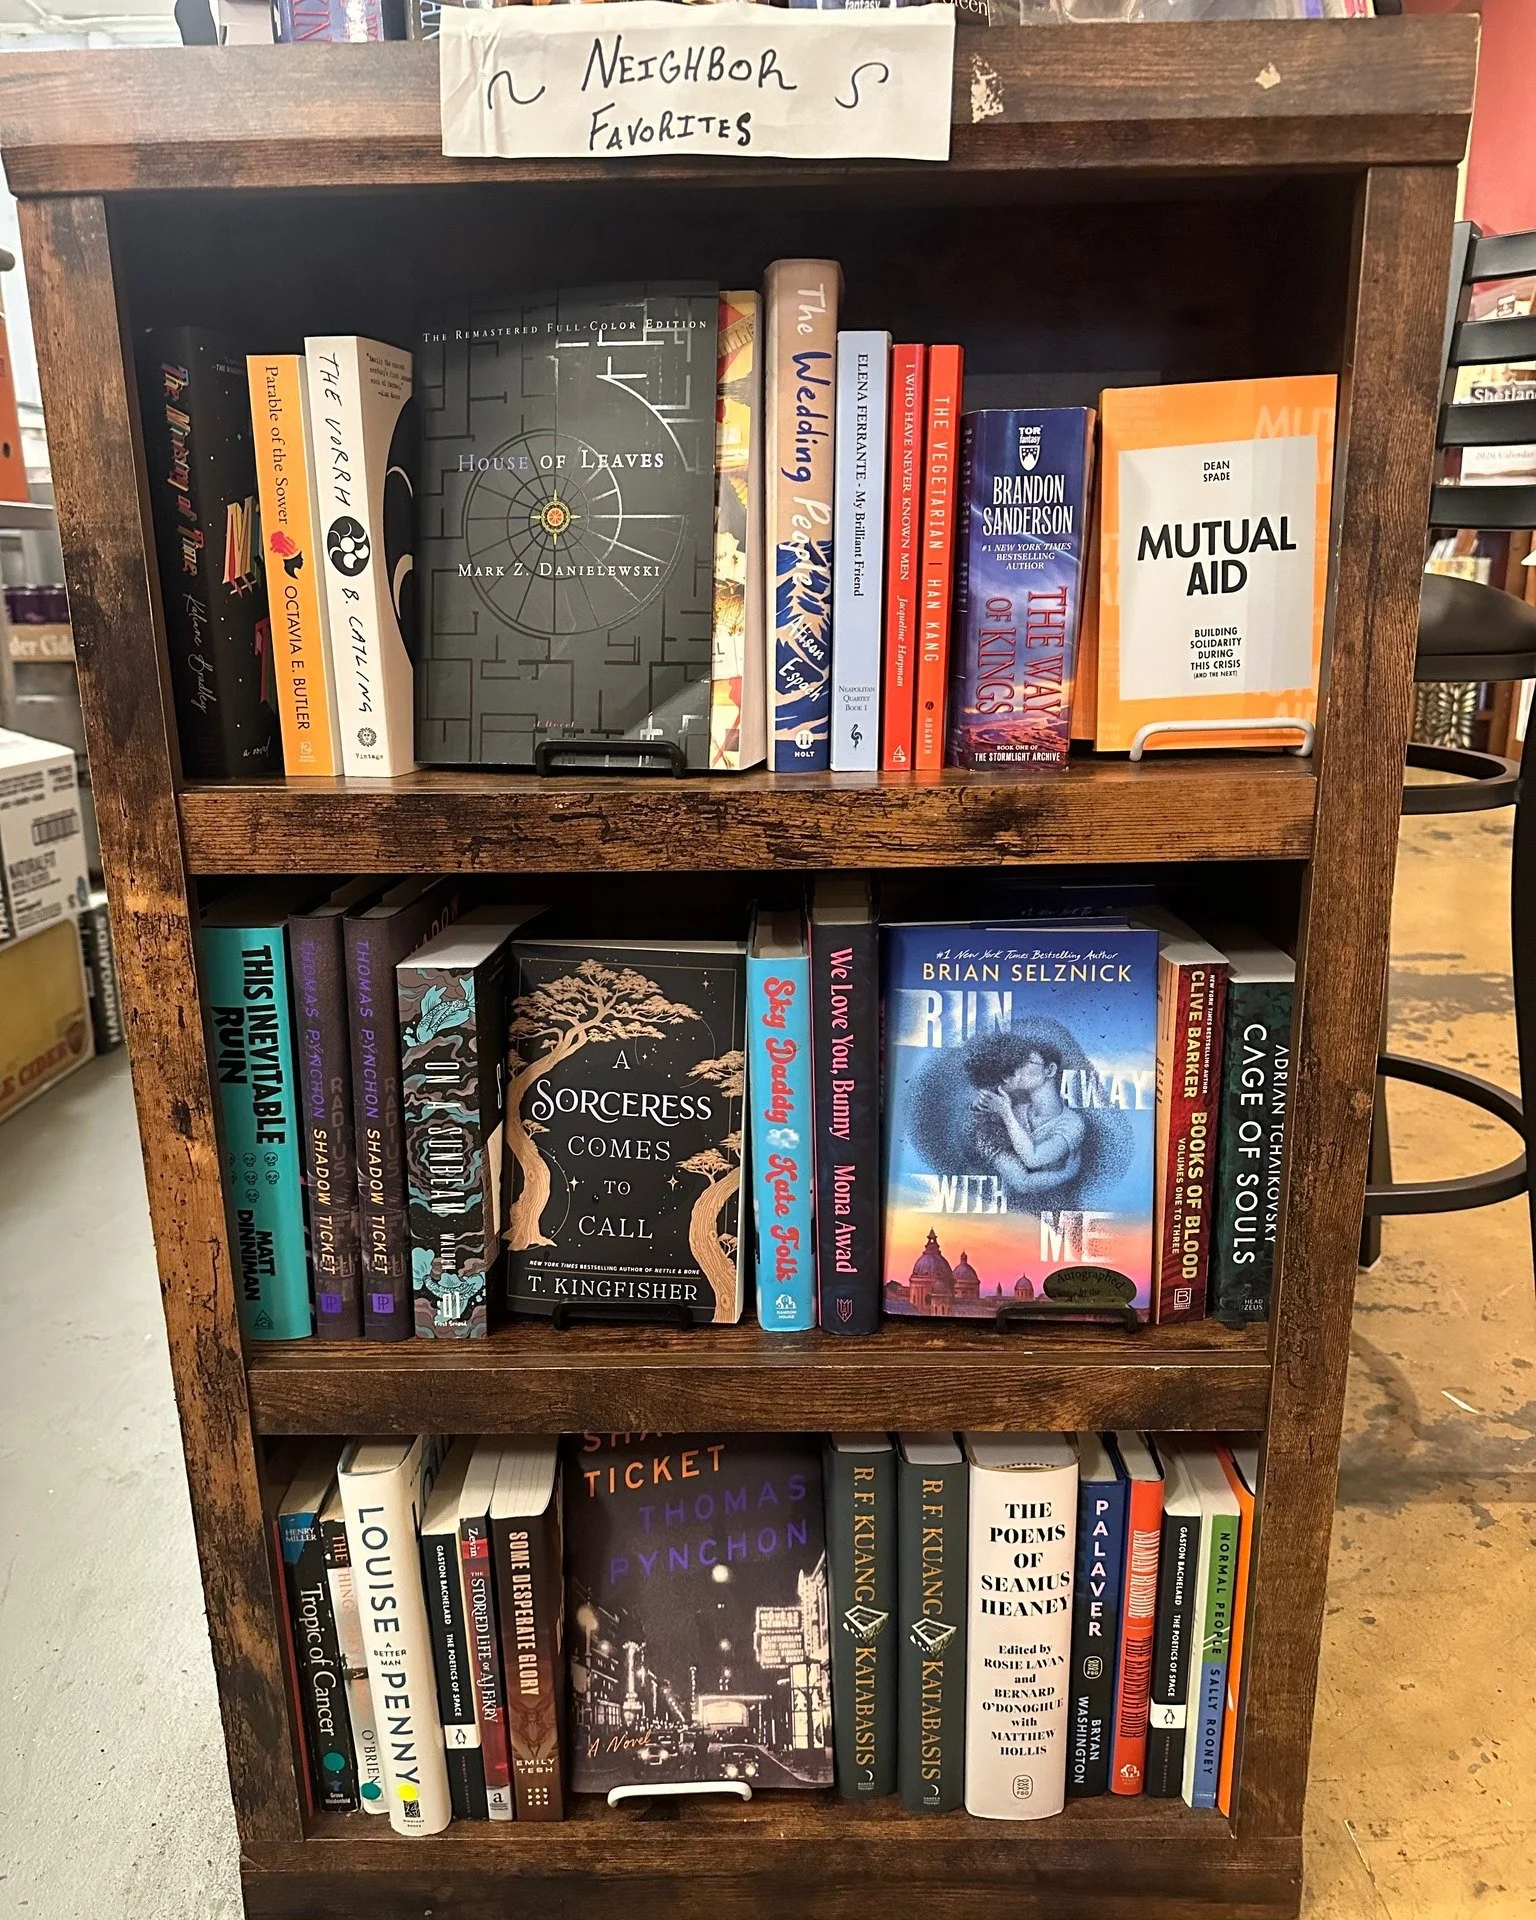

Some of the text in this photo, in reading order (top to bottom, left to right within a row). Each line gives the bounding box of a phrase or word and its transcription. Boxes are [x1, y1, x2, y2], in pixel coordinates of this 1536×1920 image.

[582, 35, 796, 92] NEIGHBOR
[588, 102, 752, 152] FAVORITES
[423, 319, 707, 342] THE REMASTERED FULL-COLOR EDITION
[905, 372, 915, 407] WHO
[1474, 388, 1536, 401] Shetlan
[265, 366, 289, 525] Parable of the Sower
[319, 353, 352, 507] THE VORRH
[780, 283, 832, 586] The Wedding People
[904, 410, 914, 448] HAVE
[1019, 426, 1040, 435] TOR
[1019, 435, 1040, 444] fantasy
[458, 450, 665, 472] HOUSE OF LEAVES
[853, 353, 868, 597] ELENA FERRANTE My Brilliant Friend
[903, 451, 912, 493] NEVER
[928, 396, 950, 549] THE VEGETARIAN
[1203, 460, 1231, 471] DEAN
[1203, 472, 1231, 483] SPADE
[993, 474, 1065, 504] BRANDON
[901, 497, 911, 548] KNOWN
[982, 506, 1073, 536] SANDERSON
[1137, 516, 1297, 561] MUTUAL
[458, 563, 660, 577] MARK Z. DANIELEWSKI
[900, 552, 909, 580] MEN
[996, 552, 1055, 561] BESTSELLING
[1005, 562, 1044, 570] AUTHOR
[1186, 559, 1248, 597] AID
[895, 595, 909, 687] Jacqueline Harpman
[924, 579, 942, 662] HAN KANG
[1194, 627, 1238, 638] BUILDING
[283, 585, 311, 730] OCTAVIA E. BUTLER
[341, 588, 373, 713] B. CATLING
[779, 614, 825, 701] Alison Espach
[974, 597, 1016, 715] OF KINGS
[1024, 585, 1068, 717] THE WAY
[1190, 636, 1242, 649] SOLIDARITY
[1198, 648, 1234, 659] DURING
[1191, 660, 1241, 671] THIS CRISIS
[1193, 671, 1208, 679] (AND
[1220, 670, 1238, 678] NEXT)
[924, 717, 933, 755] HOGARTH
[974, 751, 1060, 762] THE STORMLIGHT ARCHIVE
[922, 964, 1132, 982] BRIAN SELZNICK
[763, 976, 797, 1029] Sky
[915, 989, 1013, 1047] RUN
[210, 1006, 247, 1083] RUIN
[242, 945, 286, 1145] THIS INEVITABLE
[612, 1050, 631, 1070] A
[765, 1038, 798, 1124] Daddy
[1060, 1069, 1148, 1110] AWAY
[355, 940, 387, 1274] THOMAS PYNCHON SHADOW TICKET
[531, 1080, 712, 1127] SORCERESS
[829, 947, 857, 1274] We Love You, Bunny Mona Awad
[1182, 970, 1207, 1279] CLIVE BARKER BOOKS OF BLOOD
[1232, 1023, 1267, 1264] CAGE OF SOULS
[1264, 1044, 1289, 1242] ADRIAN TCHAIKOVSKY
[567, 1136, 671, 1161] COMES
[428, 1126, 465, 1214] SUNBEAM
[604, 1180, 631, 1195] TO
[768, 1153, 798, 1218] Kate
[922, 1174, 1007, 1213] WITH
[578, 1216, 653, 1239] CALL
[1040, 1211, 1113, 1263] ME
[237, 1209, 261, 1300] DINNIMAN
[254, 1230, 275, 1276] MATT
[440, 1233, 455, 1270] WALDEN
[770, 1225, 798, 1283] Folk
[527, 1276, 698, 1301] T. KINGFISHER
[1005, 1502, 1052, 1519] THE
[463, 1527, 478, 1557] Zevin
[988, 1524, 1066, 1543] POEMS
[358, 1506, 400, 1634] LOUISE
[1014, 1552, 1043, 1568] OF
[1088, 1500, 1108, 1637] PALAVER
[1174, 1526, 1188, 1606] GASTON BACHELARD
[981, 1571, 1070, 1593] SEAMUS
[1210, 1532, 1230, 1655] NORMAL PEOPLE
[509, 1531, 539, 1696] SOME DESPERATE GLORY
[980, 1594, 1071, 1616] HEANEY
[300, 1583, 335, 1736] Tropic of Cancer
[984, 1655, 1065, 1669] ROSIE LAVAN
[1014, 1674, 1036, 1684] and
[982, 1698, 1064, 1713] O'DONOGHUE
[994, 1686, 1055, 1698] BERNARD
[381, 1673, 421, 1785] PENNY
[991, 1729, 1055, 1740] MATTHEW
[1011, 1717, 1037, 1727] with
[1074, 1696, 1089, 1784] WASHINGTON
[1089, 1719, 1101, 1760] BRYAN
[1202, 1669, 1220, 1775] SALLY ROONEY
[1000, 1745, 1047, 1755] HOLLIS
